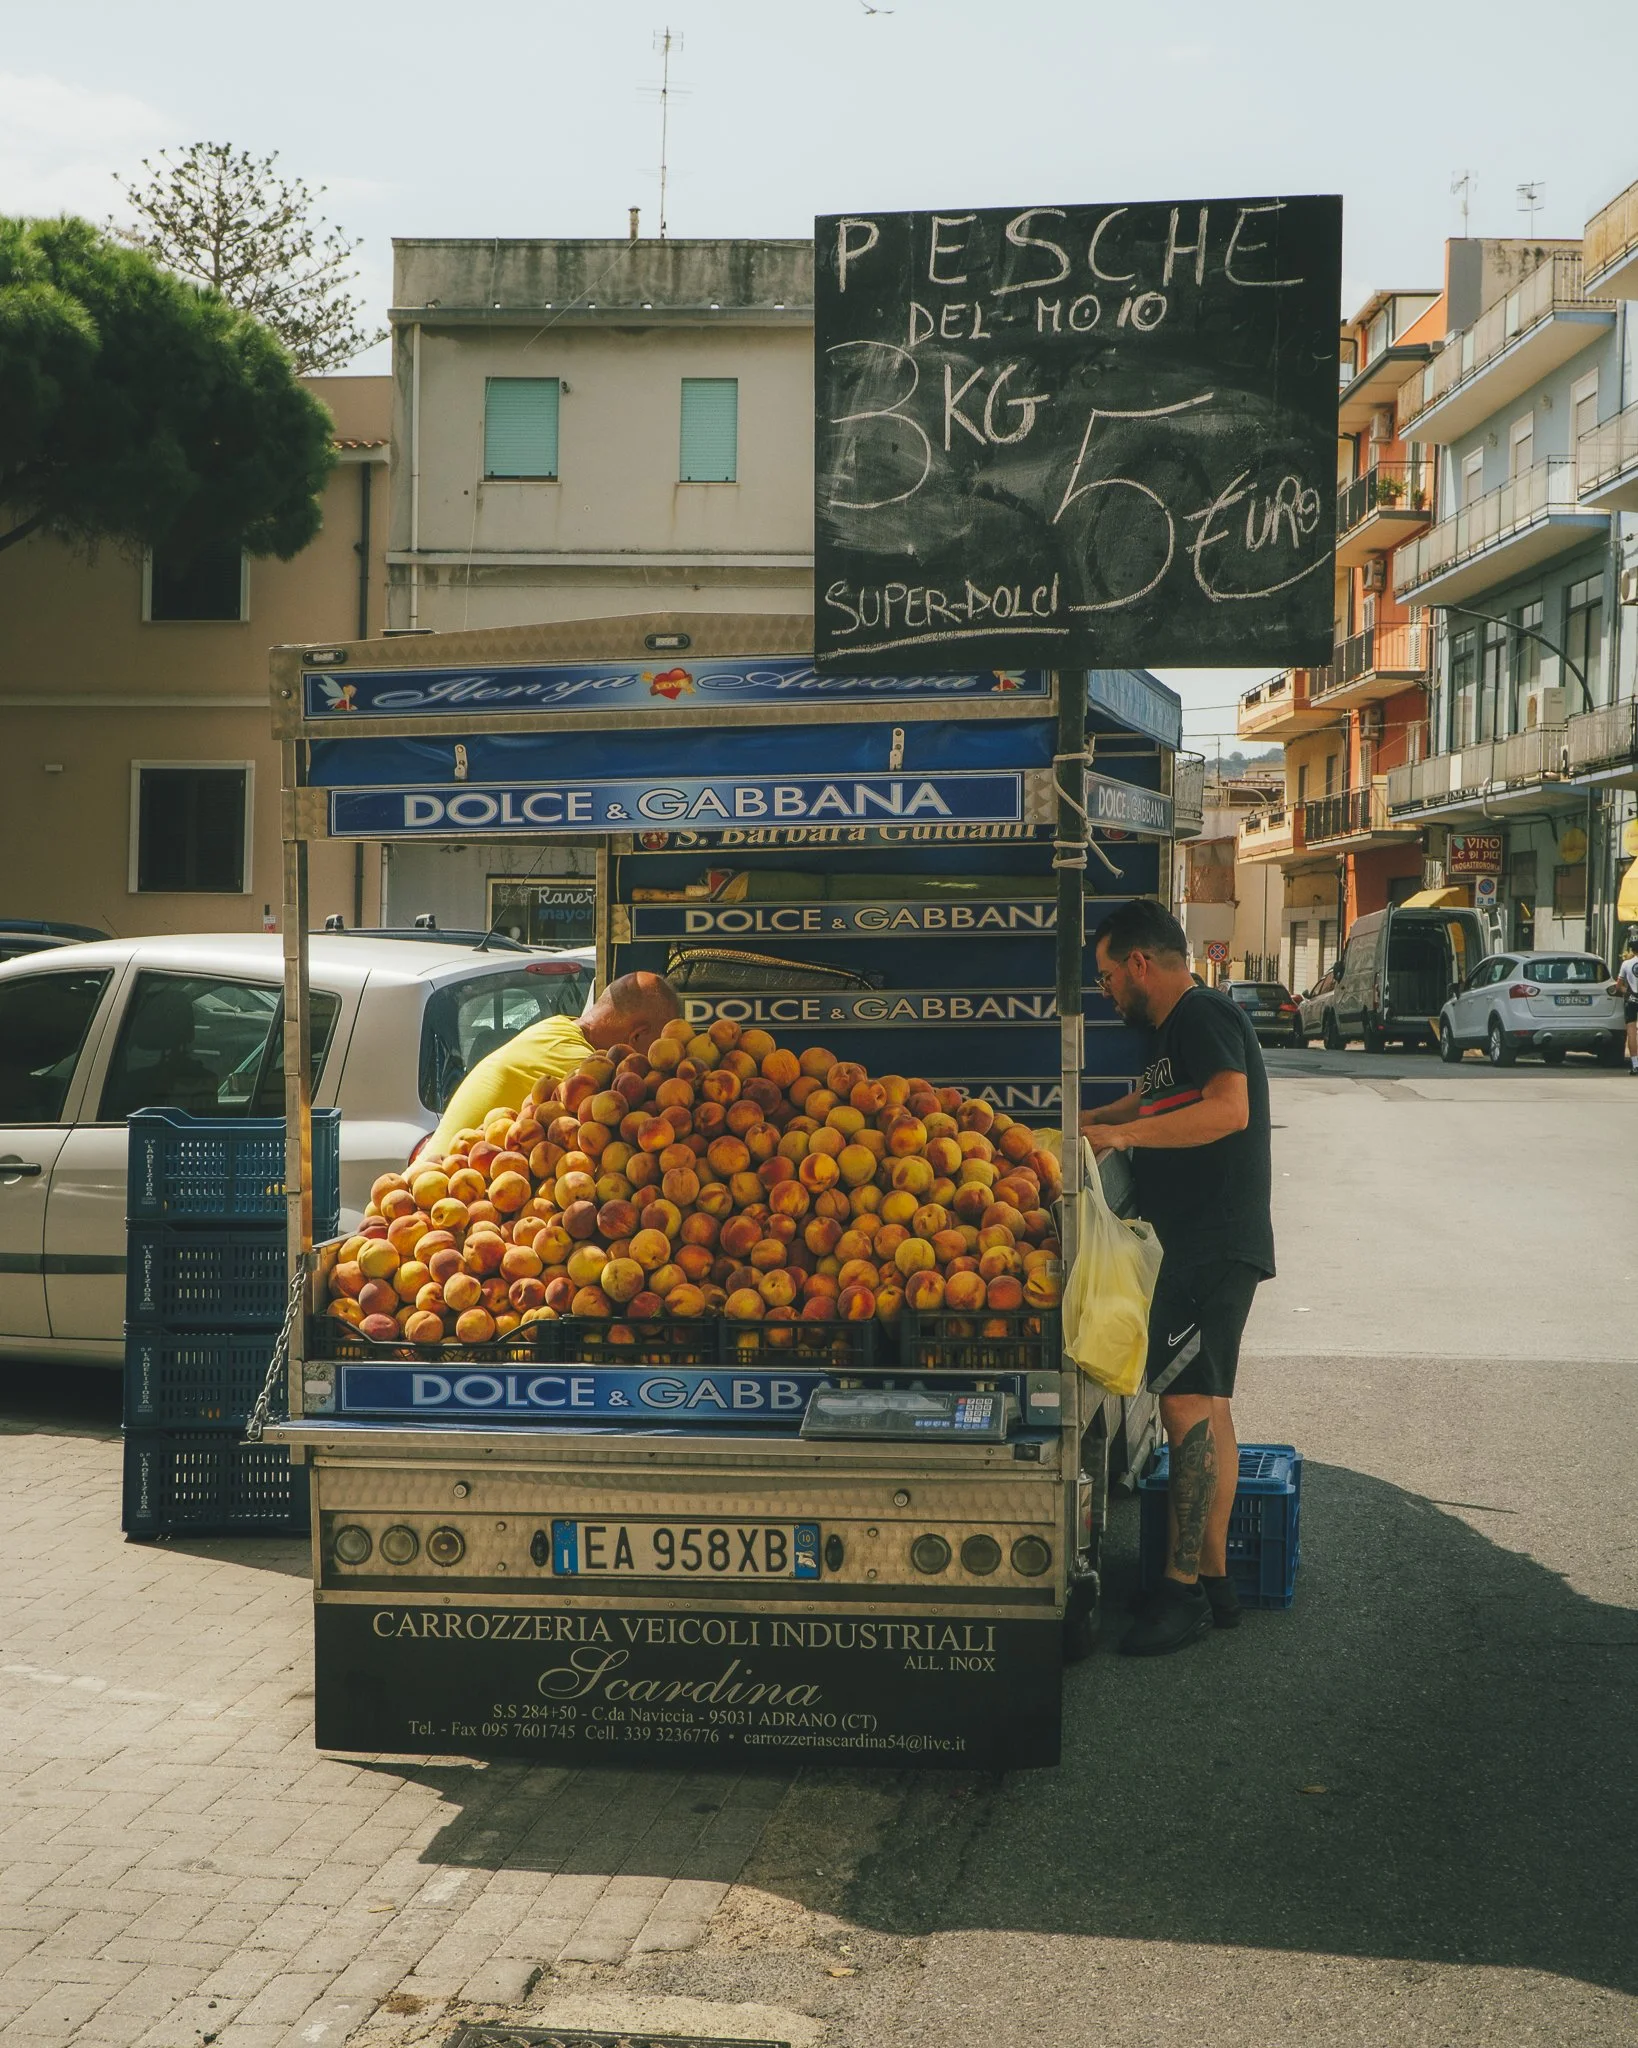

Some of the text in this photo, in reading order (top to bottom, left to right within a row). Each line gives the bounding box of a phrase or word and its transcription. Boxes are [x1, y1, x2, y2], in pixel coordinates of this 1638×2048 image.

[836, 202, 1304, 295] PESCHE
[825, 340, 1051, 509] 3 KG
[1052, 392, 1214, 612] 5
[404, 782, 952, 827] DOLCE & GABBANA
[1099, 785, 1126, 819] DOLCE
[1130, 795, 1165, 828] GABBANA
[716, 826, 867, 845] Barbara
[1466, 838, 1500, 849] VINO
[685, 909, 822, 933] DOLCE
[831, 918, 847, 929] &
[684, 1000, 821, 1024] DOLCE
[830, 1008, 845, 1019] &
[412, 1373, 596, 1407] DOLCE
[607, 1389, 632, 1406] &
[584, 1526, 635, 1570] EA
[653, 1528, 788, 1573] 958XB
[372, 1611, 997, 1652] CARROZZERIA VEICOLI INDUSTRIALI
[537, 1646, 824, 1706] Scardina
[904, 1656, 996, 1672] ALL. INOX
[408, 1720, 435, 1735] Tel.
[452, 1722, 477, 1737] Fax
[482, 1723, 508, 1738] 095
[514, 1724, 576, 1739] 7601745
[585, 1725, 619, 1740] Cell.
[624, 1726, 651, 1741] 339
[656, 1727, 719, 1743] 3236776
[744, 1730, 966, 1753] carrozzeriascardina54@live.it
[493, 1704, 517, 1718] S.S
[522, 1705, 577, 1720] 284+50
[592, 1706, 625, 1721] C.da
[630, 1708, 694, 1723] Naviccia
[709, 1710, 753, 1725] 95031
[759, 1712, 837, 1728] ADRANO
[841, 1714, 877, 1732] (CT)
